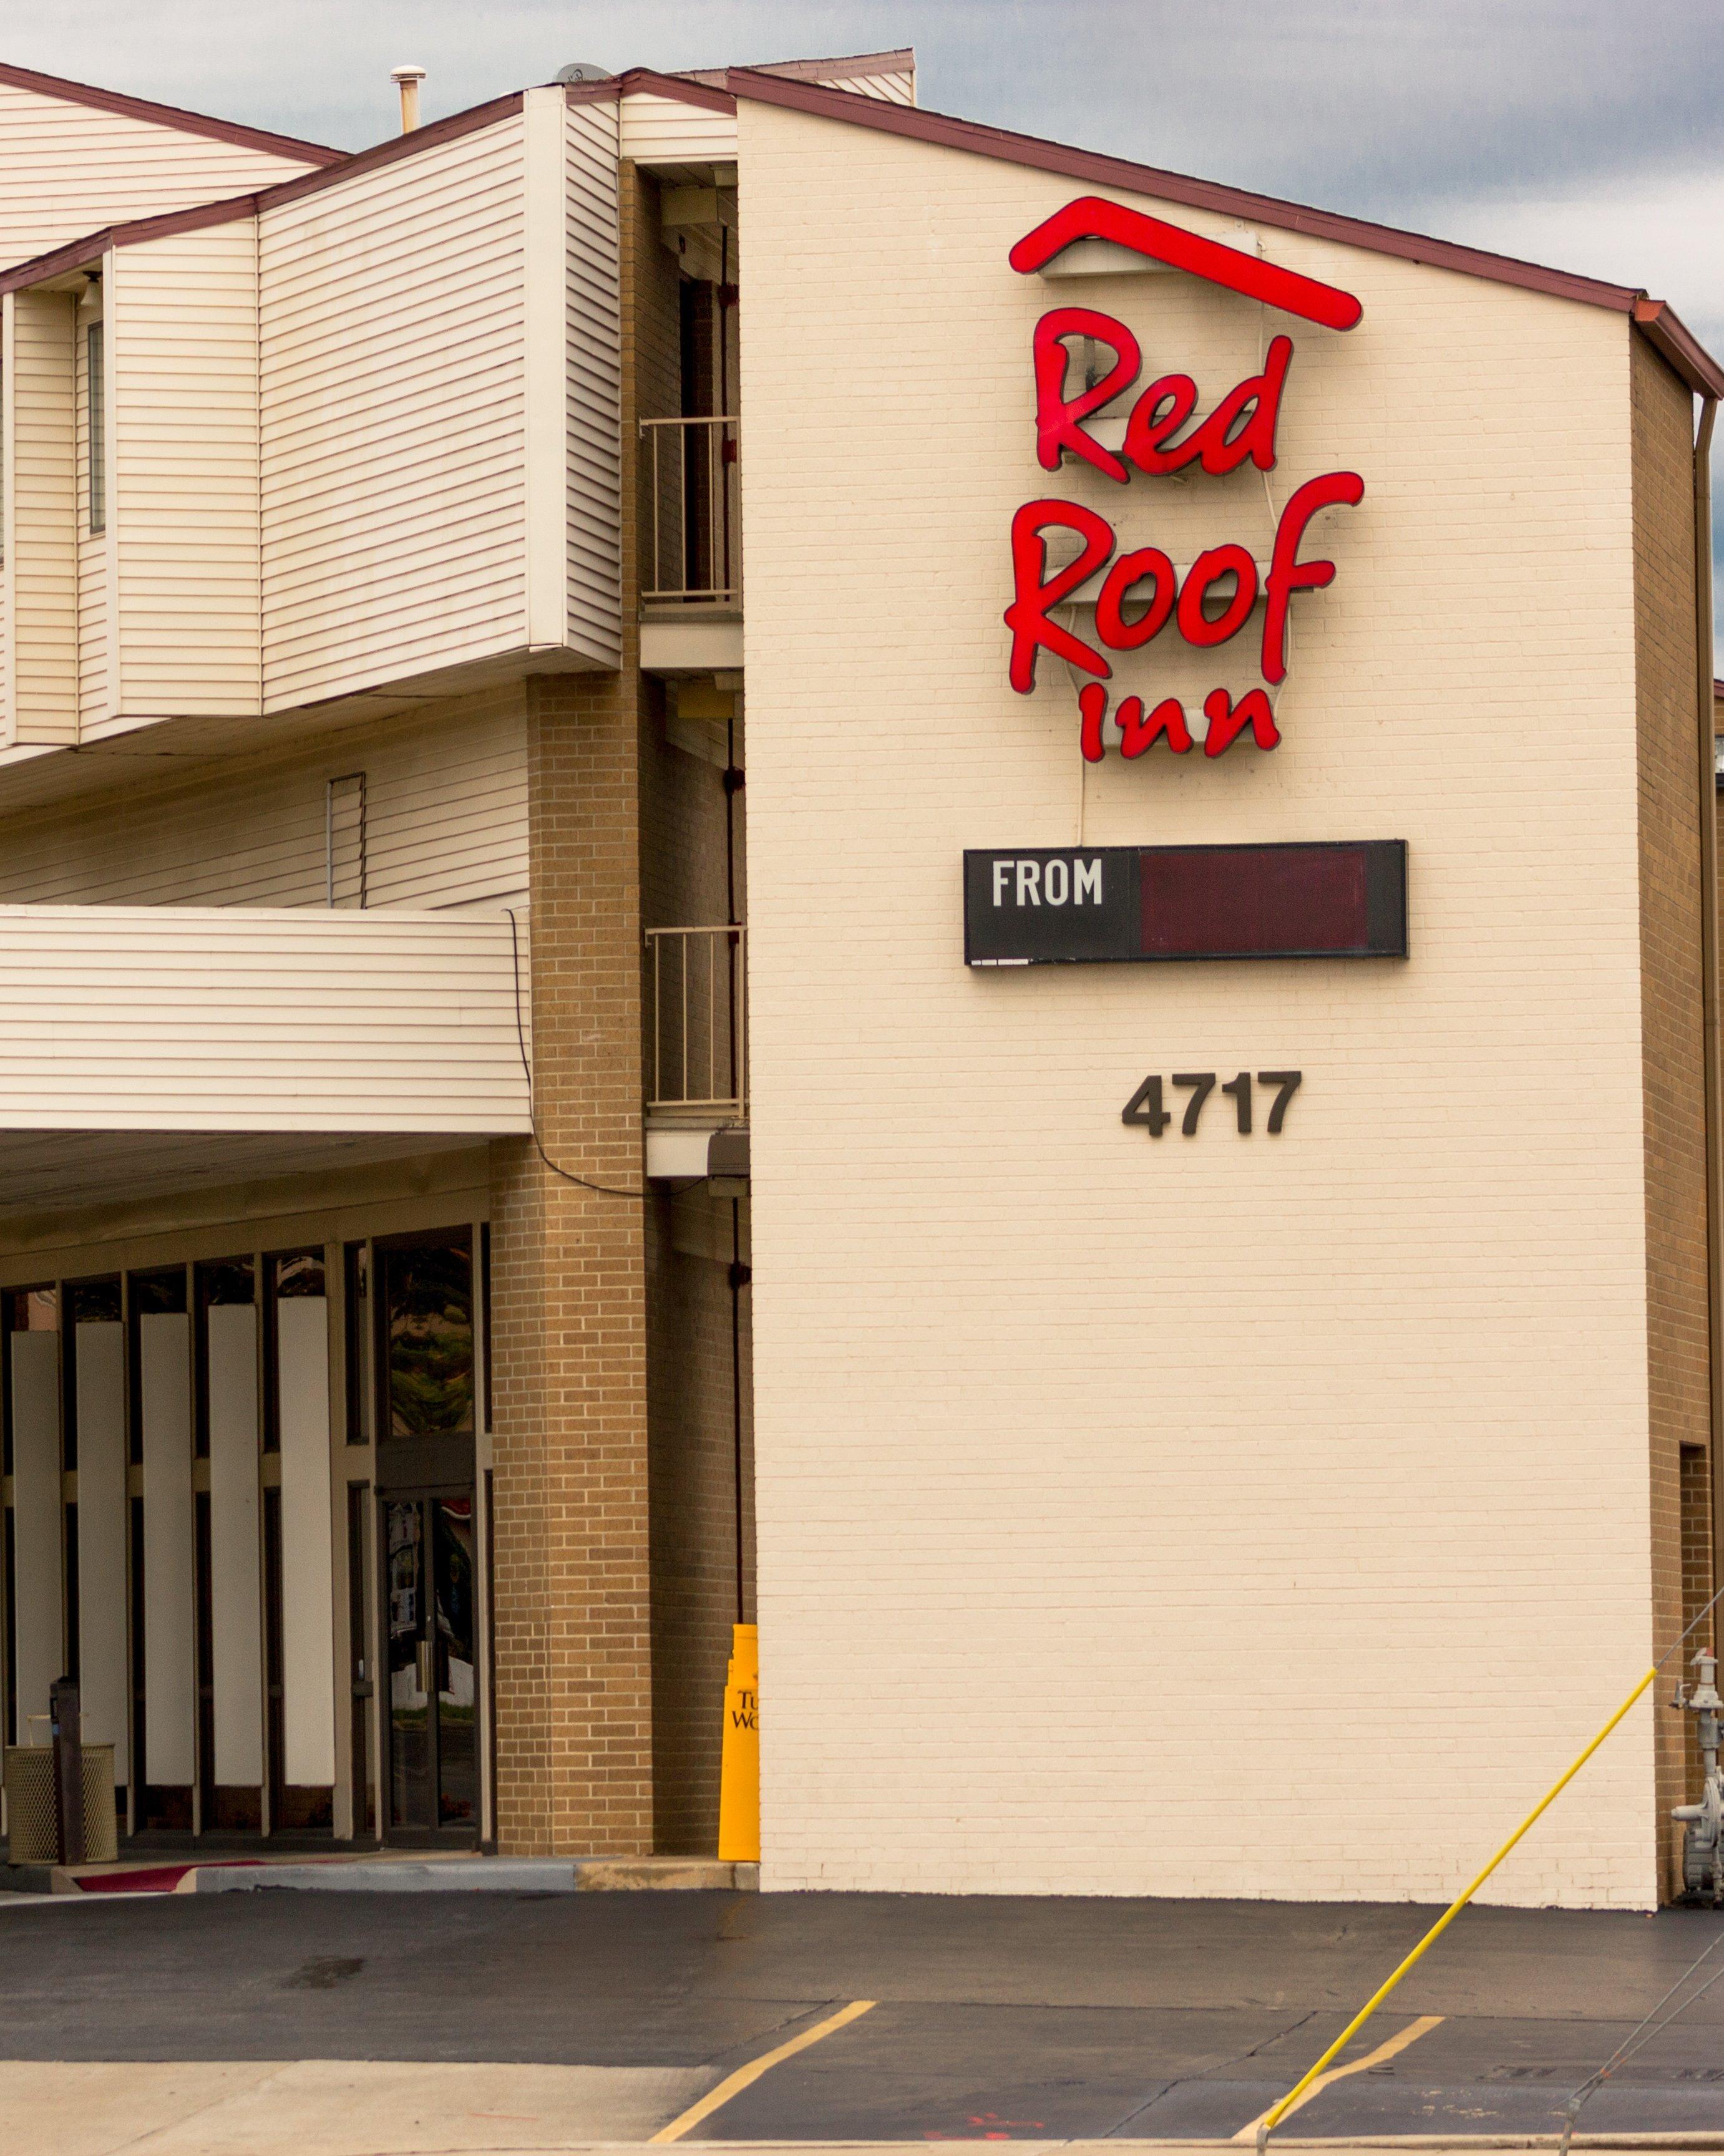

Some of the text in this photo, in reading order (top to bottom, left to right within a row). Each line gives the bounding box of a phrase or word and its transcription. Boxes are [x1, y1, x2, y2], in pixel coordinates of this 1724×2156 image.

[1033, 307, 1293, 483] Red
[1004, 472, 1365, 694] Roof
[1079, 682, 1280, 763] Inn
[992, 858, 1103, 906] FROM
[1121, 1071, 1302, 1136] 4717
